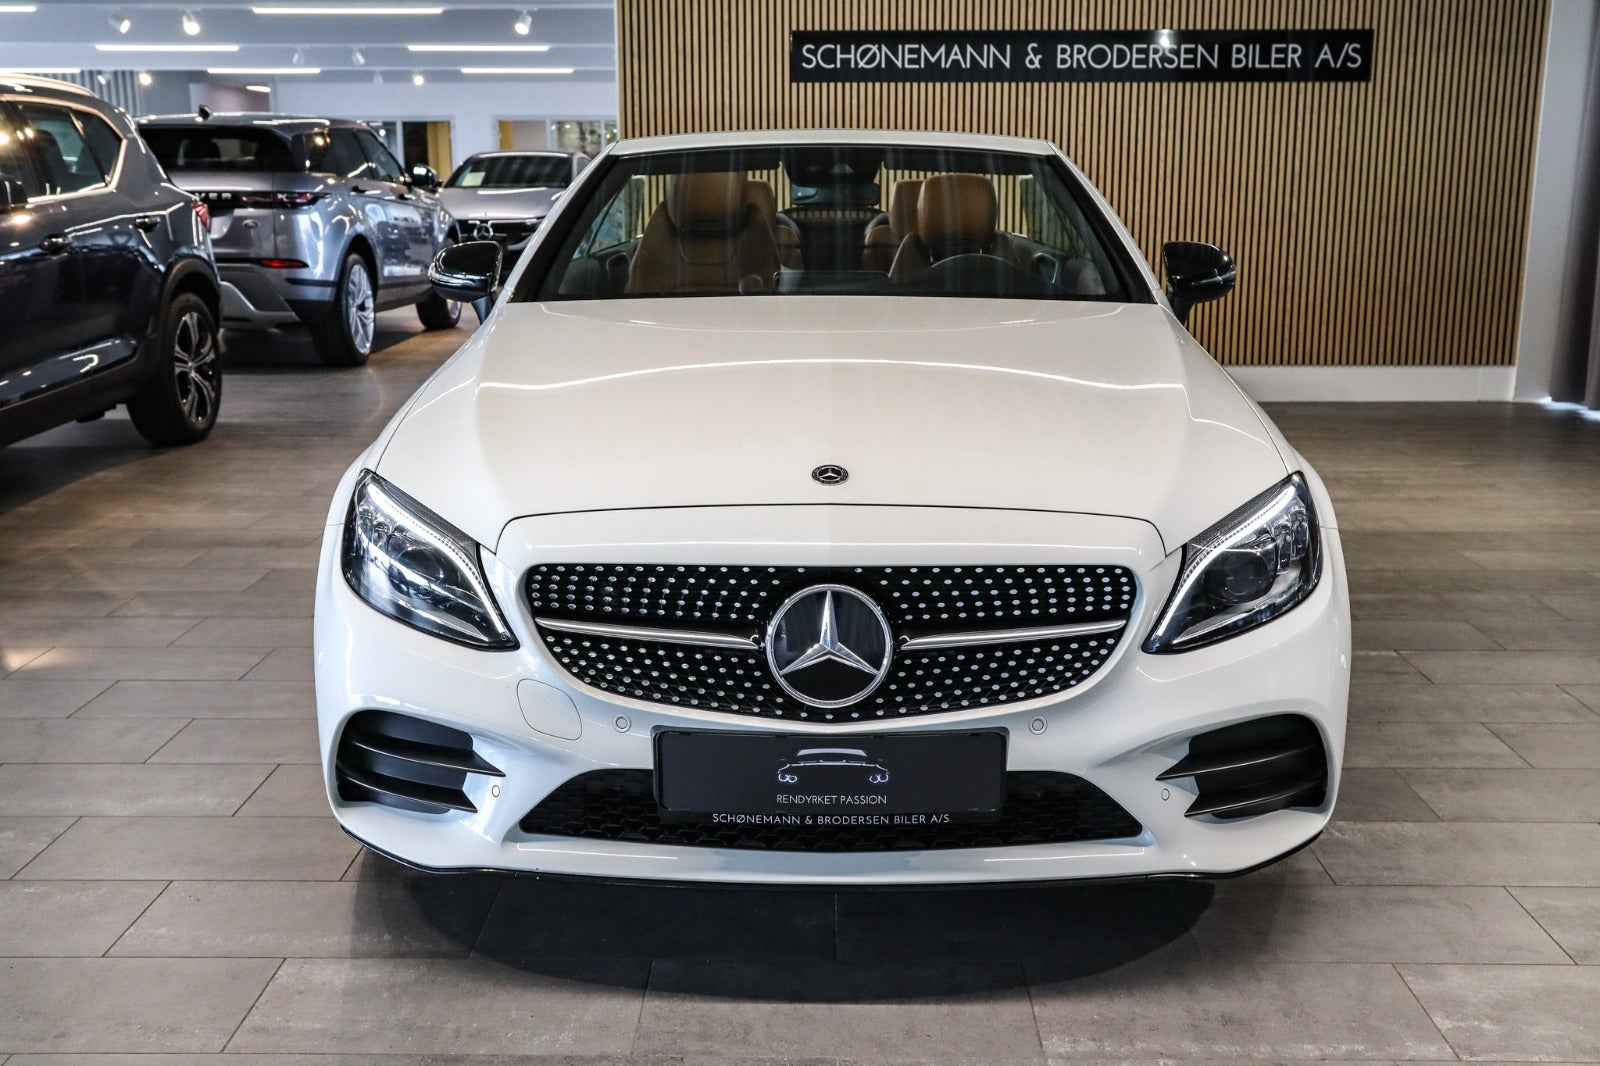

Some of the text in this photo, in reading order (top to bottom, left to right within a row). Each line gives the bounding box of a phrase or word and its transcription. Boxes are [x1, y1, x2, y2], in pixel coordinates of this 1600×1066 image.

[801, 42, 1362, 70] SCHØNEMANN & BRODERSEN BILER A/S
[776, 794, 887, 805] RENDYRKET PASSION
[712, 813, 950, 825] SCHØNEMANN & BRODERSEN BILER A/S
